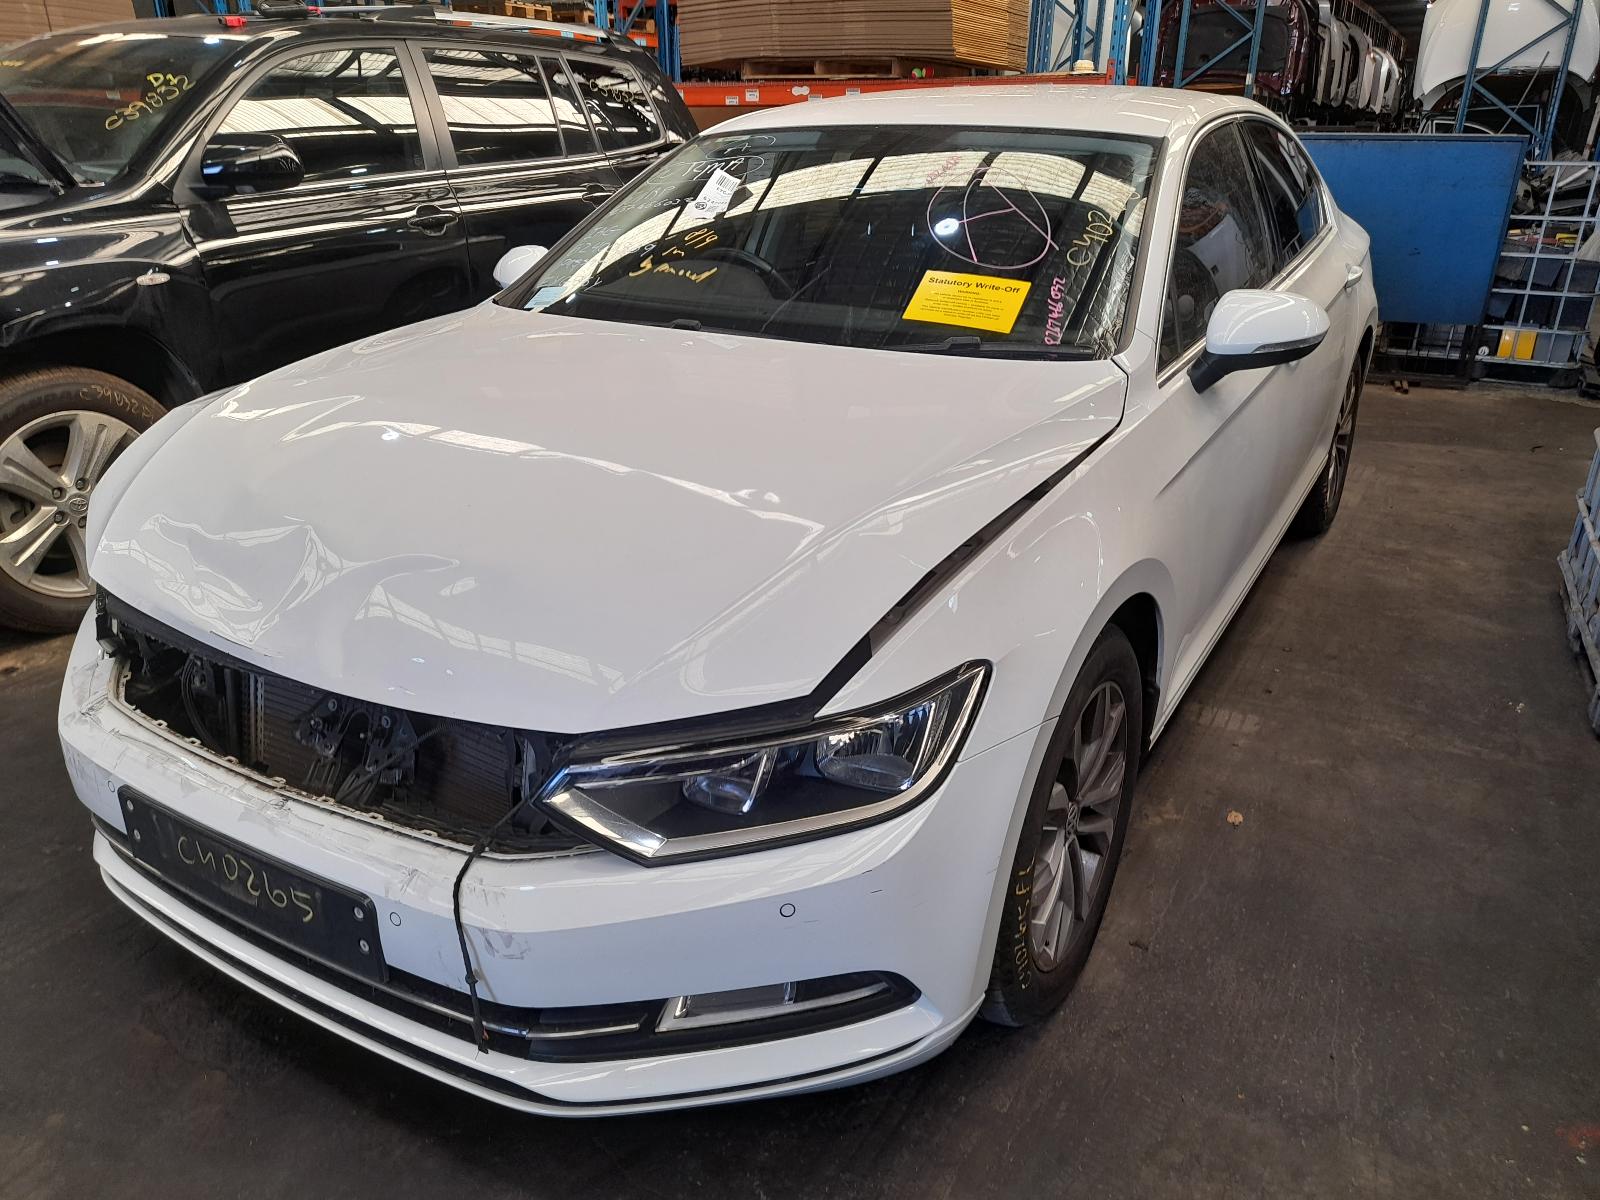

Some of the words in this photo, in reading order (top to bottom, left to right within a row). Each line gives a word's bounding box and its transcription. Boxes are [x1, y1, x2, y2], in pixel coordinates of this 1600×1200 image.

[928, 276, 973, 289] Statutory
[975, 281, 1021, 294] Write-Off
[176, 835, 315, 923] C40265
